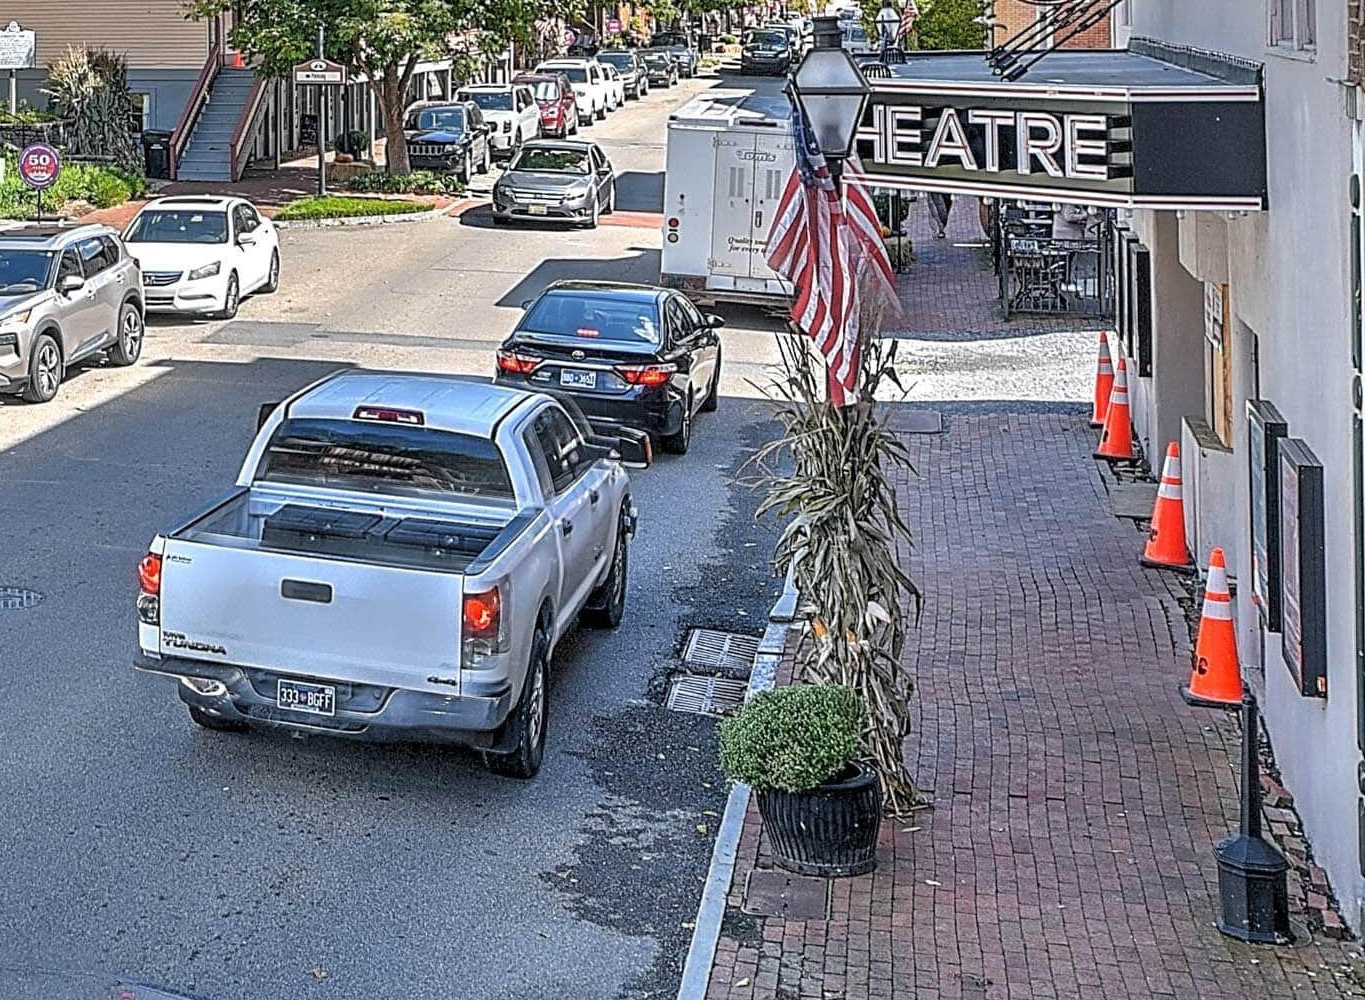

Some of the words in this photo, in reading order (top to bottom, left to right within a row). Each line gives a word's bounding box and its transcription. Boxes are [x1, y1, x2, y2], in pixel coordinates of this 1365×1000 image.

[852, 103, 1108, 181] HEATRE
[28, 154, 51, 166] 50
[162, 639, 228, 656] TUNDRA
[280, 687, 300, 704] 333
